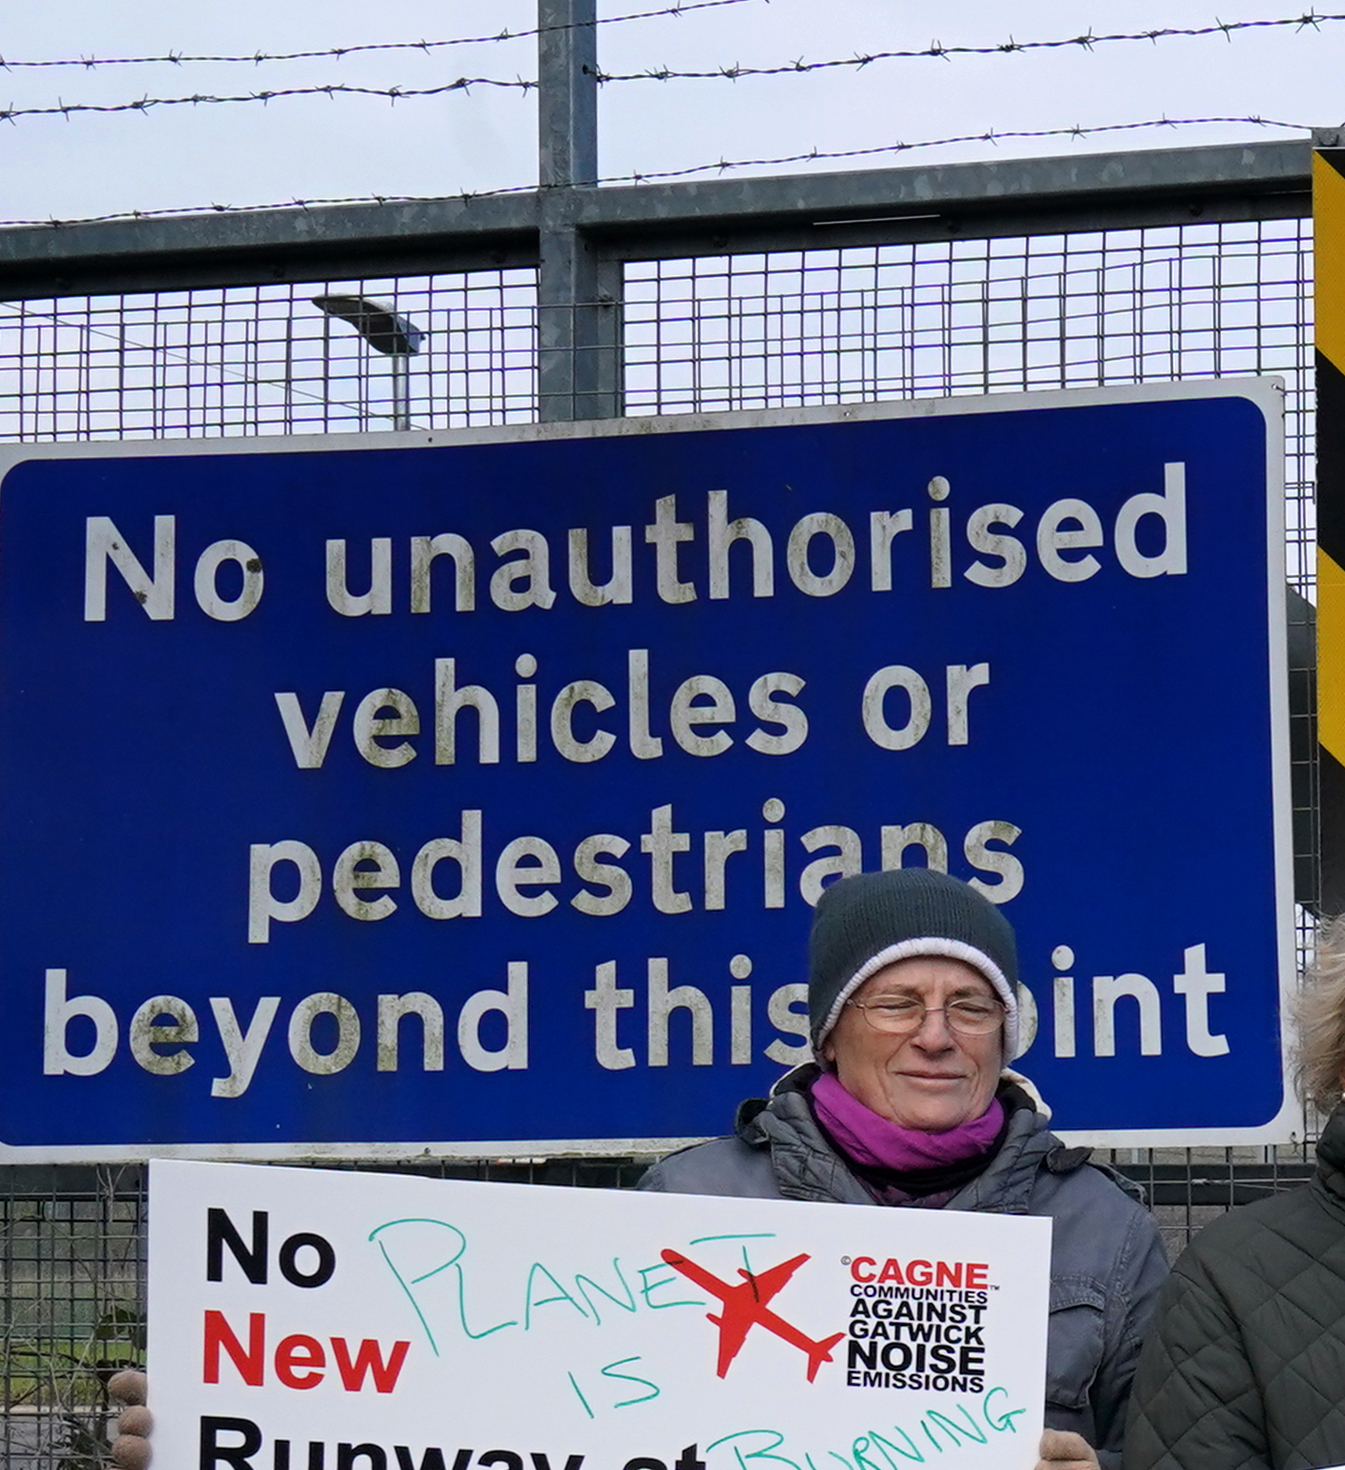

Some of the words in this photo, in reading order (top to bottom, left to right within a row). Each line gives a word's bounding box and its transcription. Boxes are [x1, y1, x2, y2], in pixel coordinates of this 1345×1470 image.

[85, 516, 263, 621] No
[327, 462, 1188, 616] unauthorised
[275, 650, 808, 769] vehicles
[863, 663, 990, 751] or
[249, 798, 1024, 944] pedestrians
[44, 962, 528, 1098] beyond
[585, 955, 808, 1066] this
[1016, 943, 1230, 1058] int
[207, 1207, 336, 1289] No
[367, 1218, 778, 1358] PLANET
[848, 1320, 985, 1346] GATWICK
[850, 1284, 988, 1305] COMMUNITIES
[850, 1298, 988, 1325] AGAINST
[202, 1309, 411, 1394] New
[567, 1356, 662, 1419] IS
[846, 1370, 984, 1394] EMISSIONS
[847, 1340, 986, 1376] NOISE
